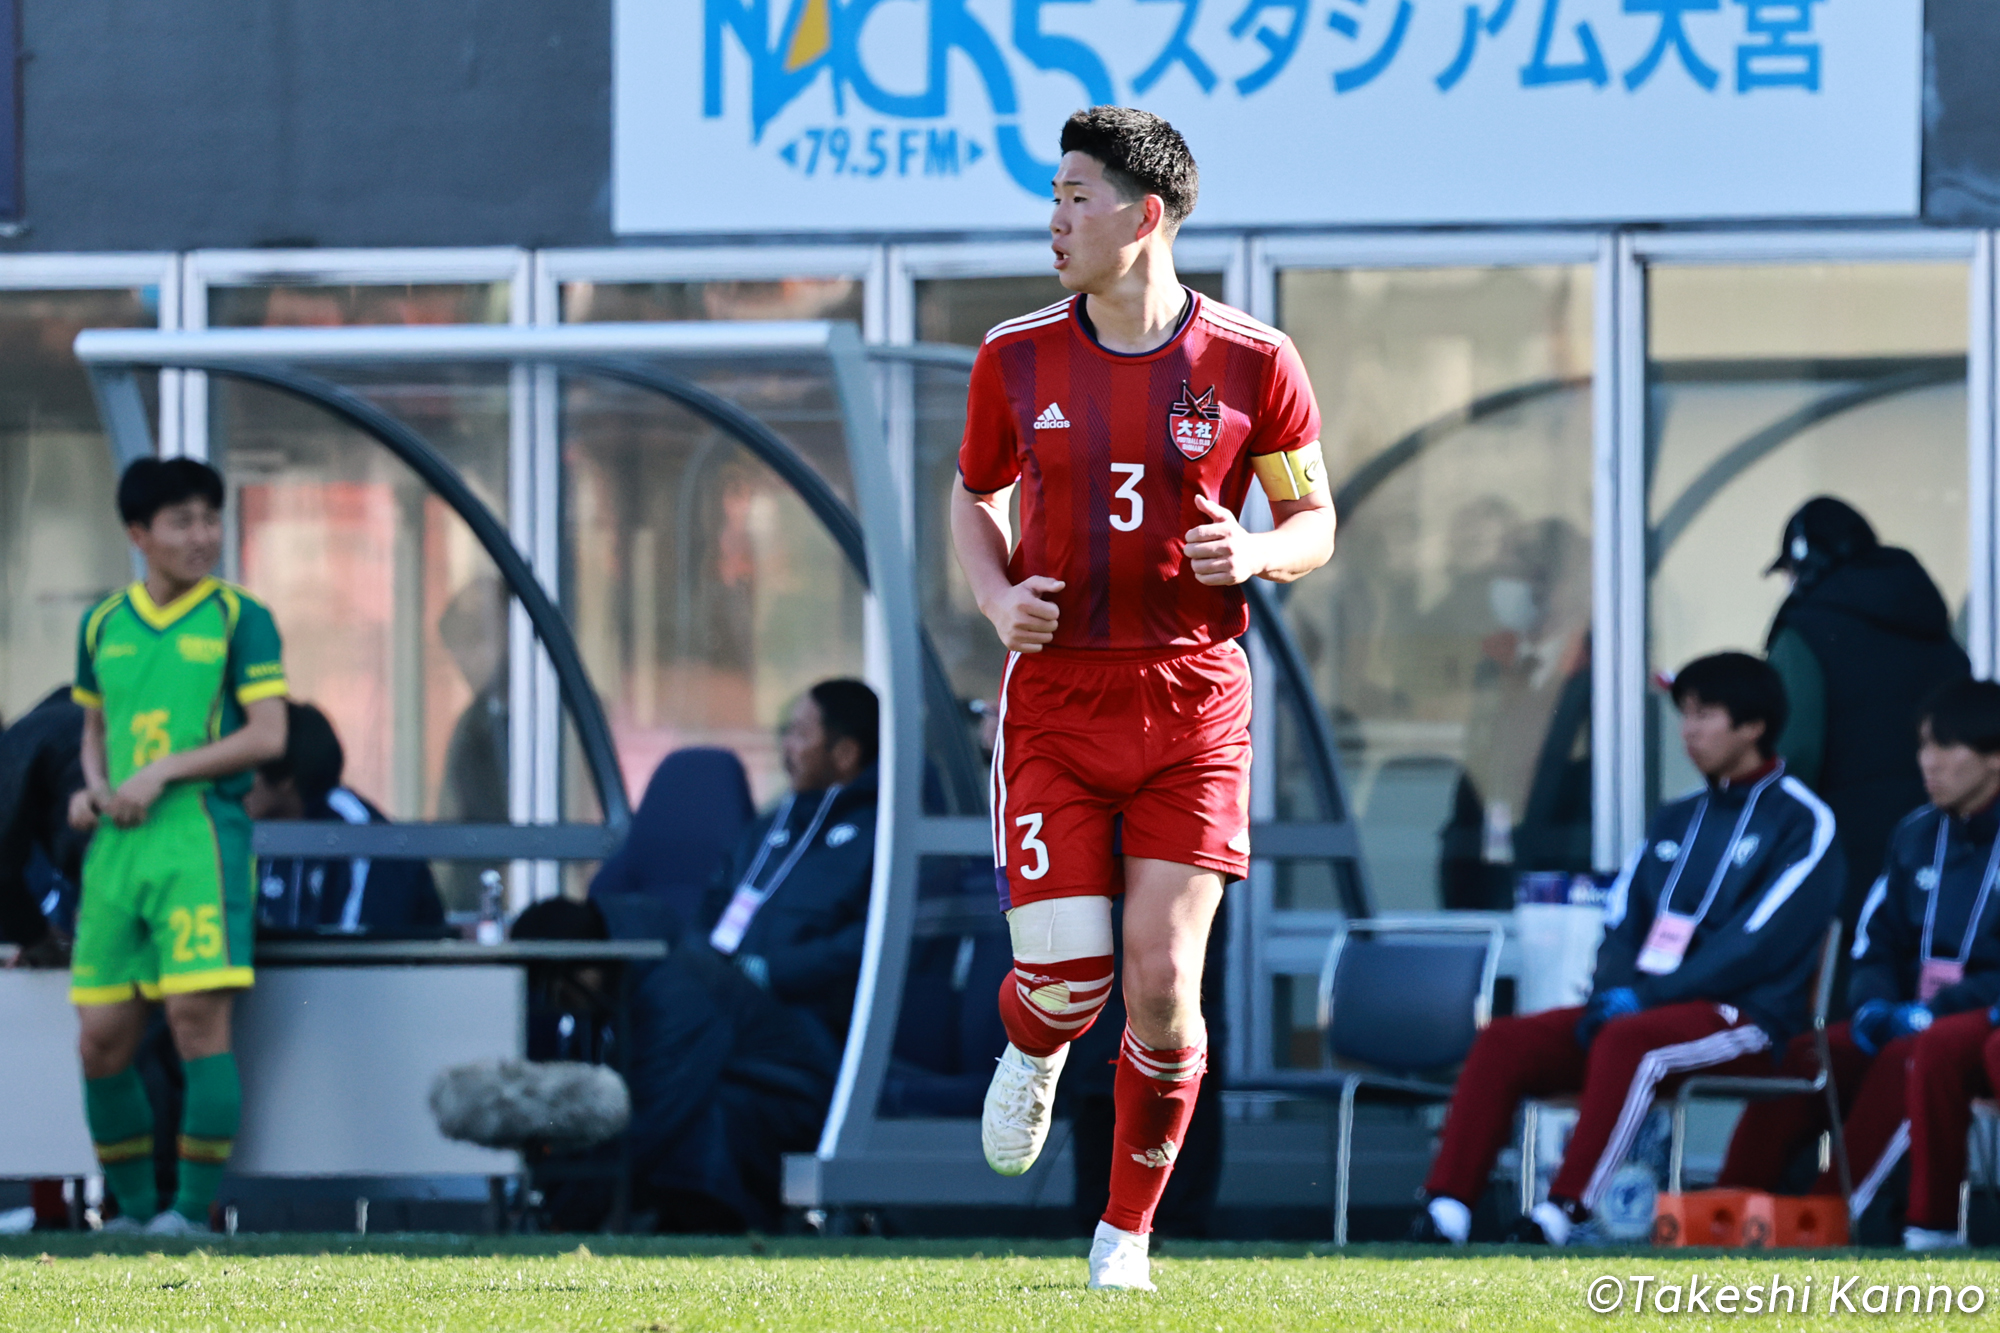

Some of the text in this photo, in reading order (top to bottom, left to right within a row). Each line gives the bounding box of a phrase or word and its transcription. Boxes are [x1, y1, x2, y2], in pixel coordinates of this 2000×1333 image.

[805, 128, 960, 178] 79.5 FM
[1033, 418, 1071, 430] adidas
[1177, 420, 1212, 438] 大社
[1109, 462, 1145, 532] 3
[1015, 812, 1050, 881] 3
[169, 904, 223, 964] 25
